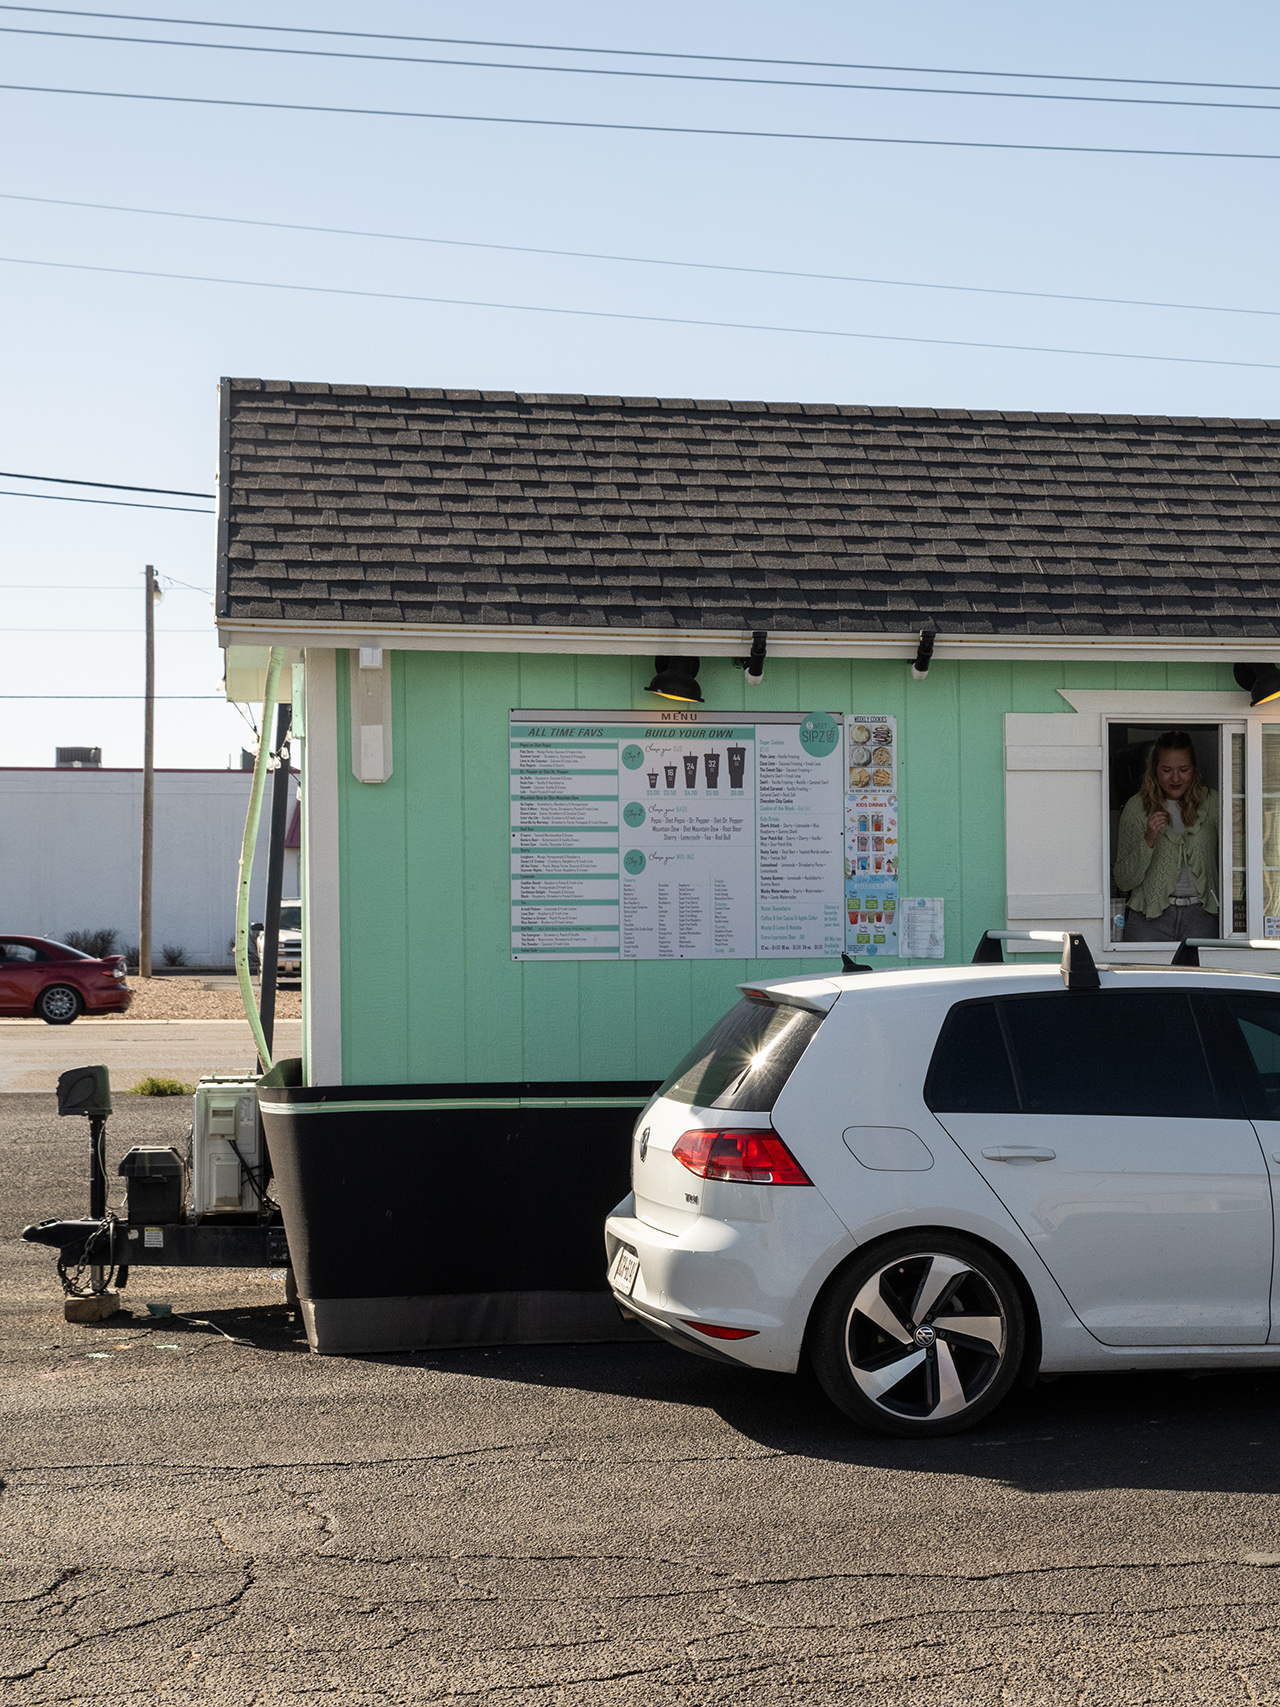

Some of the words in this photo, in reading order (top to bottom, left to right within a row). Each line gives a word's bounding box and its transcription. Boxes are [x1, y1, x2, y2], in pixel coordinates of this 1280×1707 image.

[661, 712, 698, 721] MENU
[806, 722, 828, 730] SWEET
[528, 728, 547, 737] ALL
[550, 728, 575, 737] TIME
[578, 728, 604, 737] FAVS
[645, 729, 676, 738] BUILD
[679, 729, 707, 738] YOUR
[709, 729, 734, 738] OWN
[801, 730, 825, 743] SIPZ
[645, 743, 660, 753] Choose
[660, 747, 672, 757] your
[624, 752, 638, 763] Step
[625, 809, 639, 820] Step
[648, 804, 664, 813] Choose
[664, 808, 675, 817] your
[625, 857, 639, 868] Step
[648, 852, 664, 861] Choose
[664, 856, 675, 865] your
